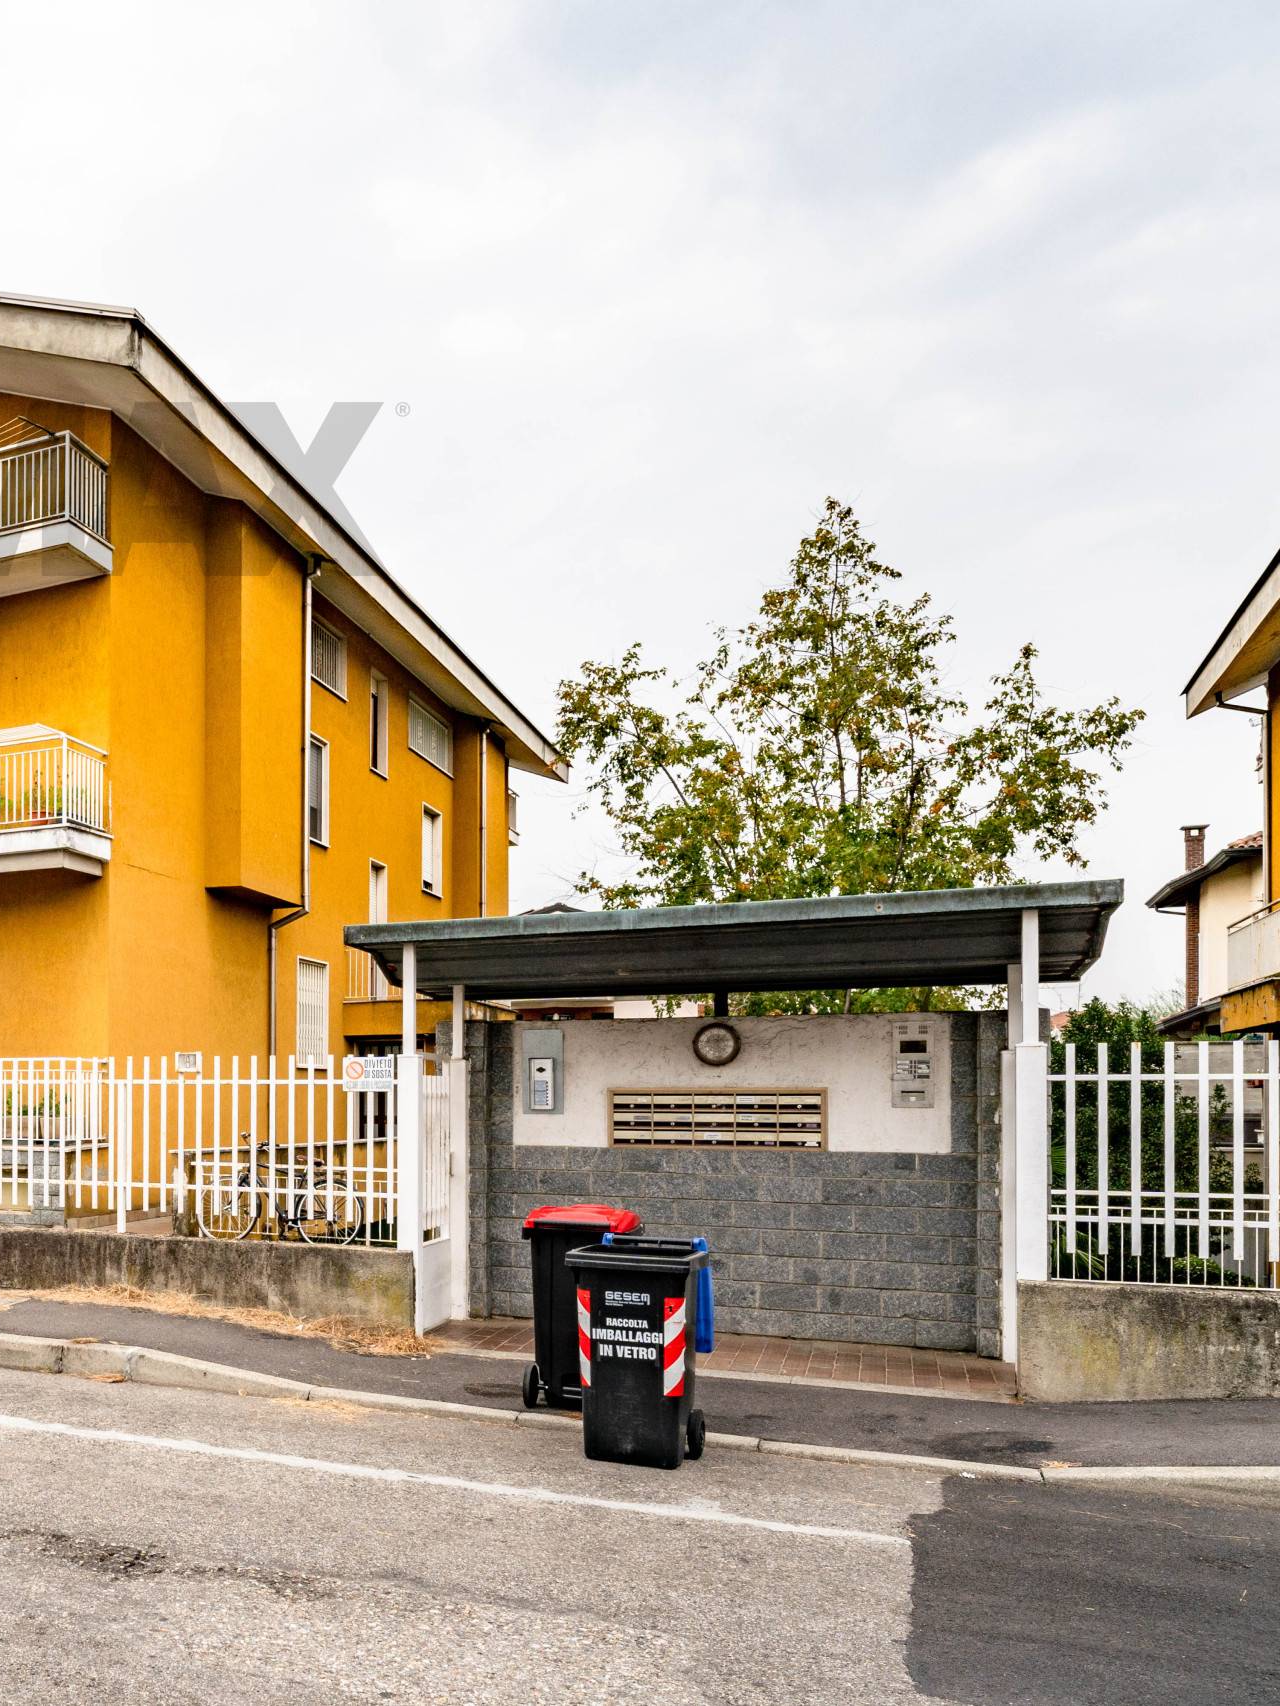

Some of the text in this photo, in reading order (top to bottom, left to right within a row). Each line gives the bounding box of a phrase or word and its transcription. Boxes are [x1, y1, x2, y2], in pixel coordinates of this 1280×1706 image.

[364, 1059, 392, 1069] DIVIETO
[364, 1069, 392, 1079] DI SOSTA
[605, 1290, 650, 1305] GESEM
[606, 1317, 648, 1329] RACCOLTA
[592, 1328, 663, 1345] IMBALLAGGI
[600, 1343, 657, 1360] IN VETRO
